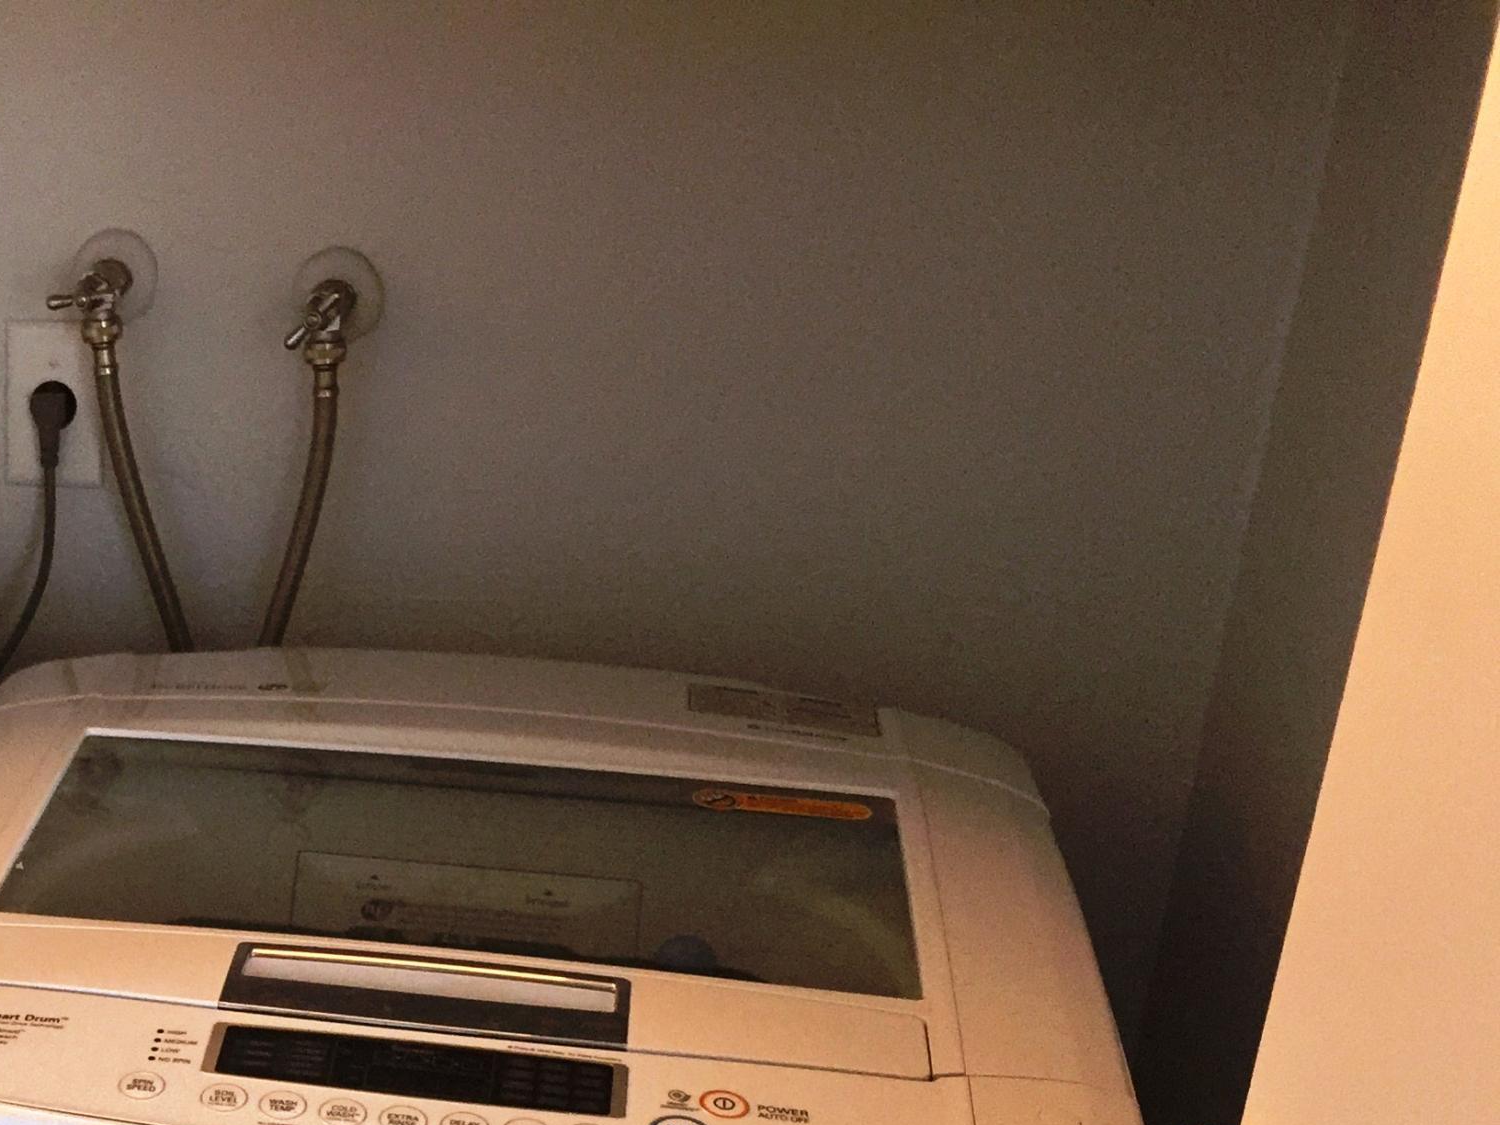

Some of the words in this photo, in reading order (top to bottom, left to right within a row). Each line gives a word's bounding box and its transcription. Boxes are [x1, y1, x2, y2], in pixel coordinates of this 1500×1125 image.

[126, 1083, 156, 1092] SPEED
[209, 1095, 237, 1103] LEVEL
[331, 1104, 358, 1112] COLD
[757, 1104, 809, 1117] POWER
[387, 1113, 419, 1121] EXTRA
[758, 1112, 789, 1121] AUTO
[790, 1116, 810, 1124] OFF
